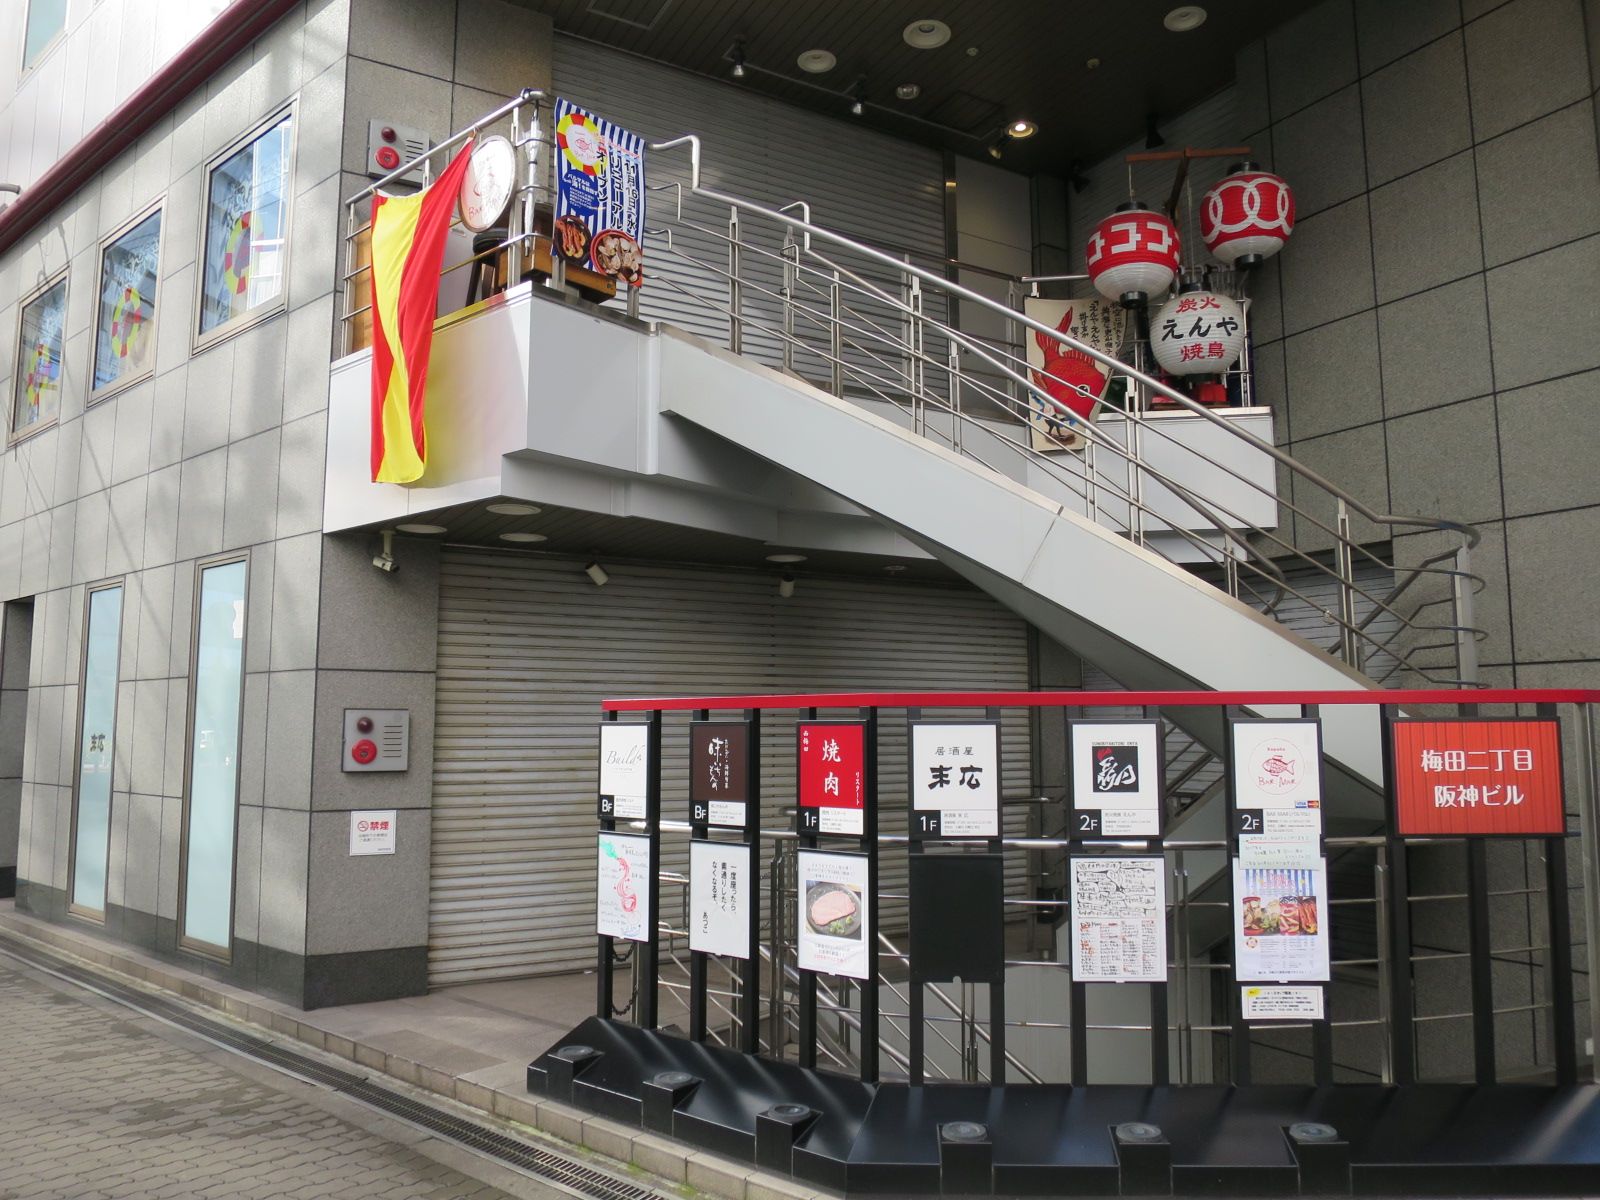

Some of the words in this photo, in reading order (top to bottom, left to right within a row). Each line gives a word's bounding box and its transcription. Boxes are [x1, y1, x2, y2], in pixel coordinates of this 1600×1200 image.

[596, 151, 608, 203] オープン
[610, 155, 624, 231] リニューアル
[1175, 296, 1221, 314] 炭火
[1161, 316, 1239, 342] えんや
[1179, 340, 1226, 363] 焼鳥
[934, 746, 974, 756] 居酒屋
[821, 738, 842, 797] 焼肉
[1420, 749, 1533, 773] 梅田二丁目
[927, 764, 983, 790] 末広
[1433, 785, 1525, 808] 阪神ビル
[601, 799, 613, 813] BF
[694, 805, 707, 820] BF
[369, 821, 389, 831] 禁煙
[803, 811, 817, 828] 1F
[920, 815, 937, 832] 1F
[1079, 814, 1098, 831] 2F
[1241, 814, 1260, 831] 2F
